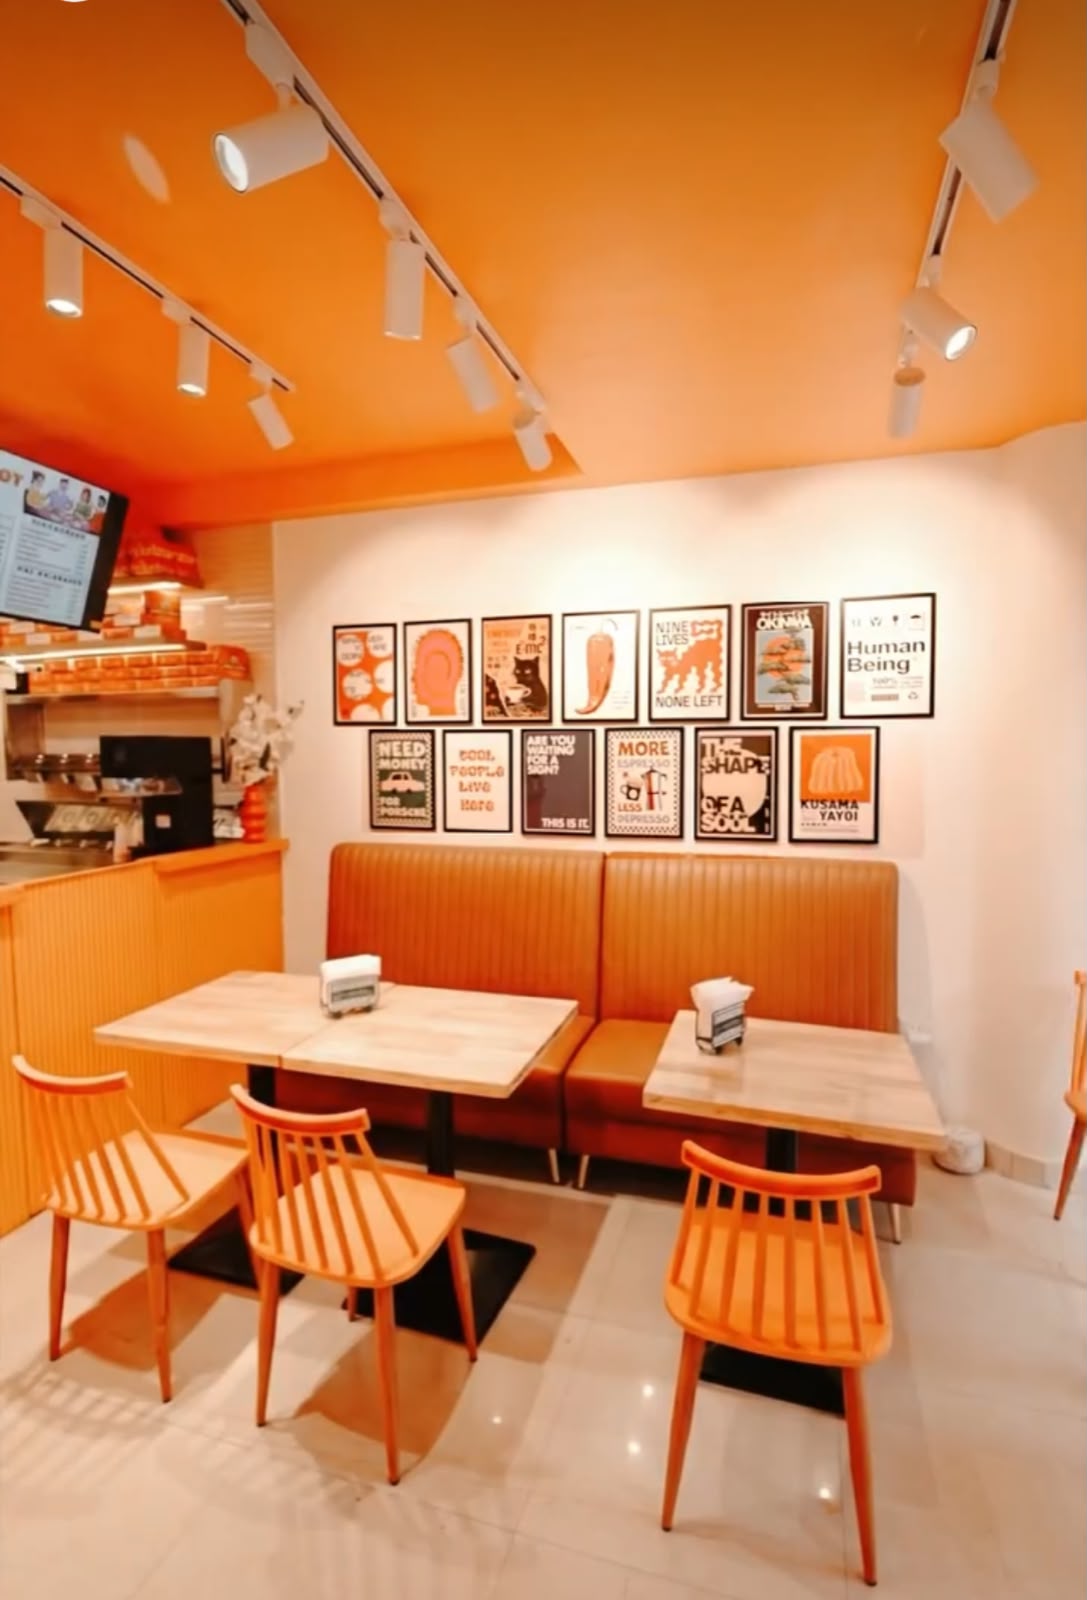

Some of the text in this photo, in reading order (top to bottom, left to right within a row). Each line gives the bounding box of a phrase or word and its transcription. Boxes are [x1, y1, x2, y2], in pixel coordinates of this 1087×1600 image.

[656, 621, 688, 633] NINE
[656, 634, 688, 646] LIVES
[847, 641, 925, 655] Human
[847, 656, 910, 675] Being
[656, 695, 723, 708] NONE LEFT
[527, 735, 576, 746] ARE YOU
[379, 740, 426, 757] NEED
[527, 745, 575, 756] WAITING
[618, 740, 670, 756] MORE
[701, 737, 742, 757] THE
[379, 758, 426, 770] MONEY
[527, 755, 560, 765] FOR A
[618, 759, 671, 768] ESPRESSO
[702, 756, 770, 774] SHAPE
[618, 803, 642, 812] LESS
[702, 796, 745, 813] OF A
[800, 798, 860, 810] KUSAMA
[541, 817, 565, 828] THIS
[566, 817, 577, 828] IS
[618, 814, 671, 823] DEPRESSO
[701, 812, 756, 833] SOUL
[819, 811, 858, 822] YAYOI
